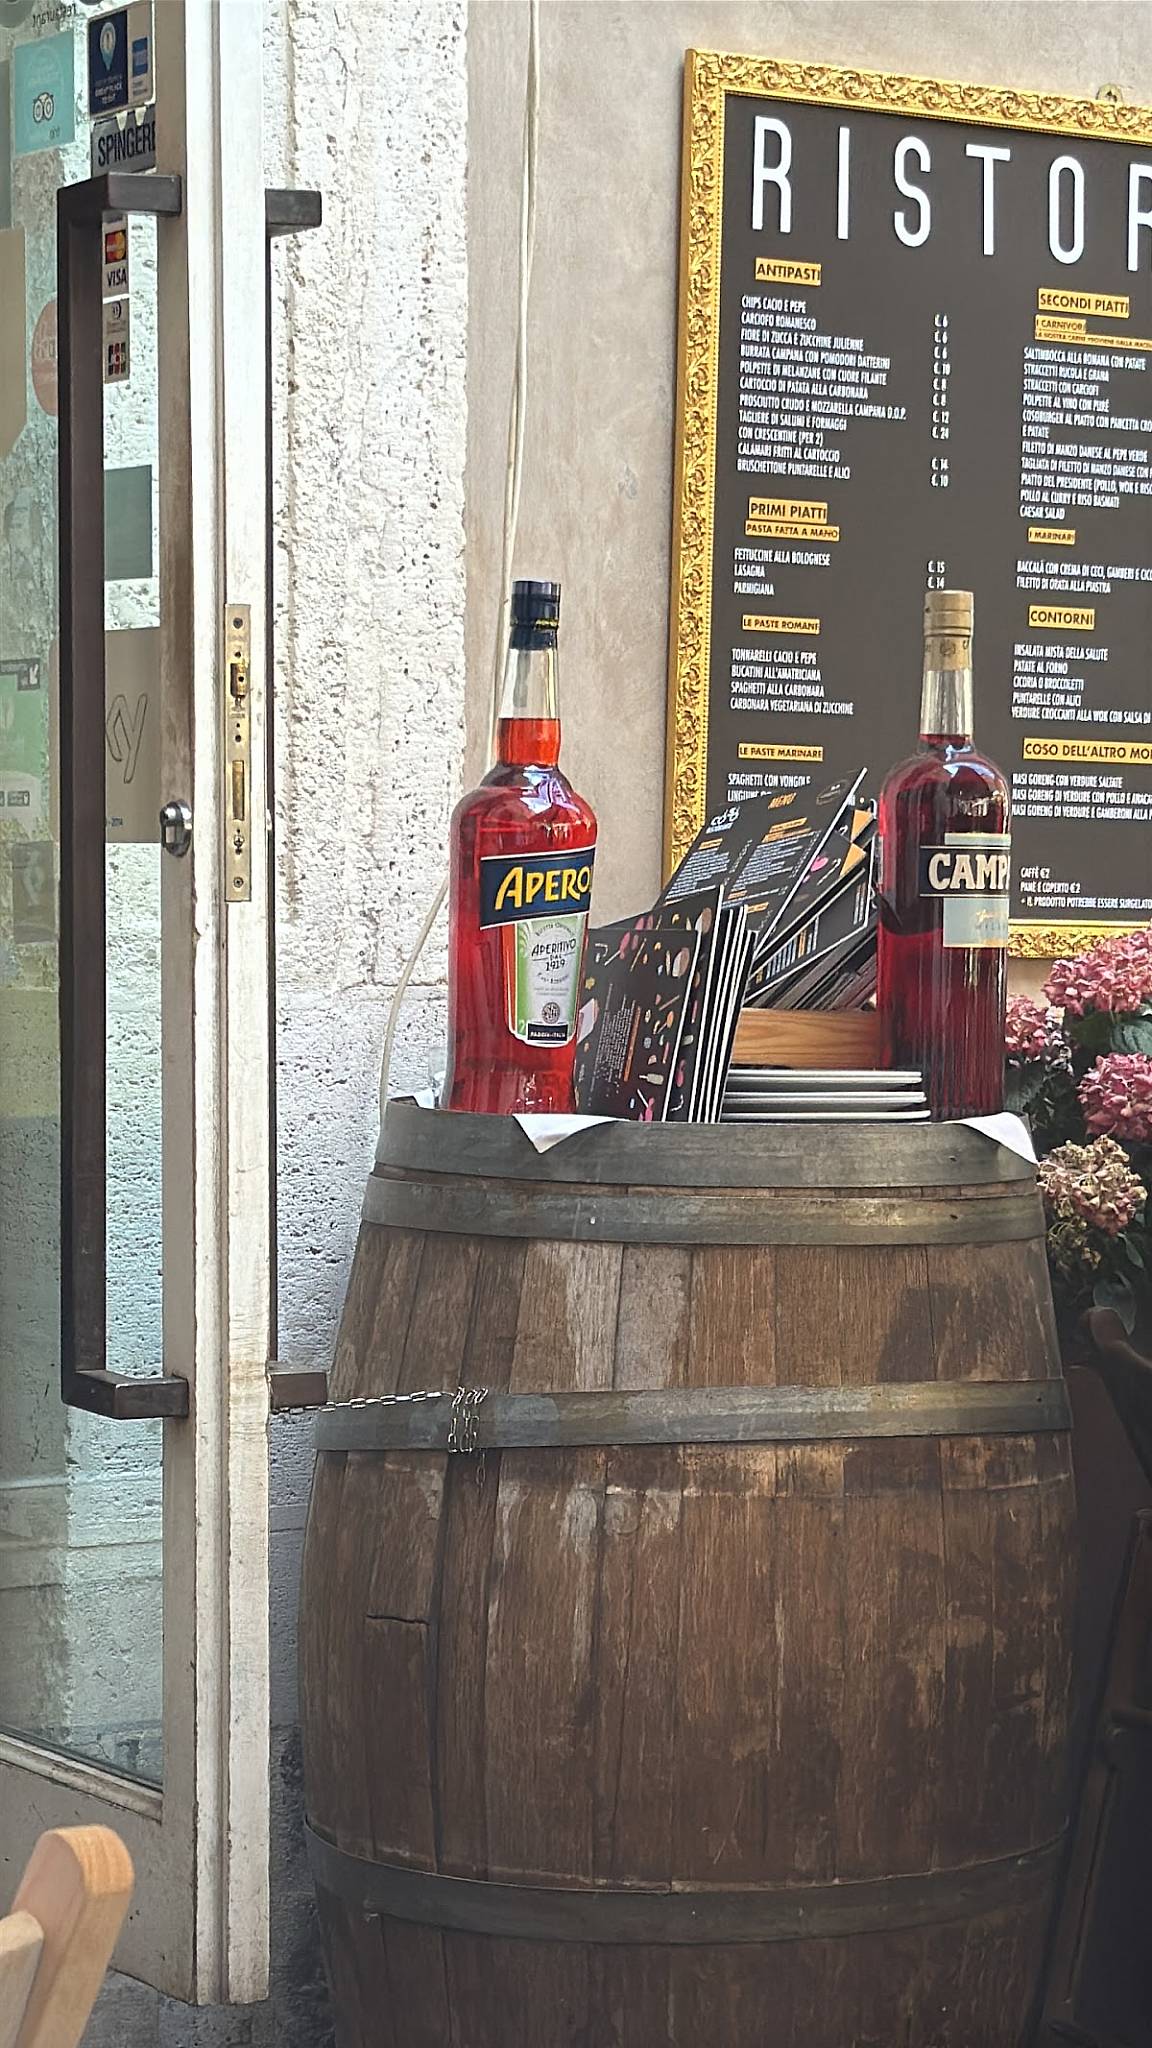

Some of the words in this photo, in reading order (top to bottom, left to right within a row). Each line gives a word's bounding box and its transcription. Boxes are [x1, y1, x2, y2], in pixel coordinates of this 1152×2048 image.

[107, 268, 128, 288] VISA
[756, 263, 821, 281] ANTIPASTI
[741, 295, 762, 309] CHIPS
[763, 297, 783, 311] CACIO
[784, 299, 789, 312] E
[790, 299, 807, 313] PEPE
[1040, 293, 1091, 309] SECONDI
[1095, 299, 1128, 313] PIATTI
[741, 312, 775, 327] CARCIOFO
[775, 315, 817, 331] ROMANESCO
[741, 328, 760, 342] FIORE
[761, 330, 770, 343] DI
[771, 331, 793, 345] ZUCCA
[794, 333, 799, 346] E
[799, 333, 833, 348] ZUCCHINE
[833, 336, 864, 351] JULIENNE
[740, 345, 771, 359] BURRATA
[772, 347, 804, 362] CAMPANA
[805, 350, 820, 363] CON
[820, 351, 857, 366] POMODORI
[857, 354, 891, 369] DATTERINI
[740, 361, 771, 376] POLPETTE
[773, 363, 781, 376] DI
[782, 364, 820, 380] MELANZANE
[822, 367, 837, 381] CON
[838, 369, 860, 383] CUORE
[861, 371, 887, 385] FILANTE
[739, 377, 777, 392] CARTOCCIO
[778, 380, 786, 393] DI
[787, 380, 811, 395] PATATA
[811, 382, 828, 396] ALLA
[828, 384, 869, 400] CARBONARA
[739, 394, 780, 410] PROSCIUTTO
[781, 397, 804, 412] CRUDO
[805, 399, 810, 412] E
[811, 400, 853, 416] MOZZARELLA
[854, 403, 886, 418] CAMPANA
[887, 406, 907, 420] D.O.P.
[739, 410, 769, 425] TAGLIERE
[771, 413, 779, 425] DI
[780, 413, 805, 427] SALUMI
[806, 415, 811, 428] E
[811, 416, 847, 431] FORMAGGI
[941, 411, 950, 424] 12
[738, 426, 753, 440] CON
[754, 427, 797, 443] CRESCENTINE
[798, 431, 815, 444] (PER
[815, 432, 824, 446] 2)
[940, 427, 949, 440] 24
[738, 442, 772, 457] CALAMARI
[773, 445, 793, 459] FRITTI
[794, 446, 803, 460] AL
[803, 447, 840, 462] CARTOCCIO
[940, 474, 949, 487] 10
[750, 502, 786, 517] PRIMI
[790, 505, 827, 520] PIATTI
[746, 524, 772, 534] PASTA
[775, 526, 799, 536] FATTA
[801, 528, 808, 536] A
[810, 528, 838, 539] MANO
[734, 547, 773, 563] FETTUCCINE
[774, 550, 790, 564] ALLA
[791, 551, 831, 566] BOLOGNESE
[734, 564, 765, 578] LASAGNA
[936, 560, 945, 574] 15
[733, 582, 775, 596] PARMIGIANA
[936, 576, 945, 589] 14
[743, 618, 752, 627] LE
[754, 619, 779, 629] PASTE
[1030, 610, 1093, 625] CONTORNI
[731, 648, 772, 662] TONNARELLI
[773, 650, 793, 663] CACIO
[795, 651, 799, 664] E
[800, 651, 817, 665] PEPE
[731, 665, 763, 679] BUCATINI
[764, 666, 821, 682] ALL'AMATRICIANA
[730, 681, 766, 695] SPAGHETTI
[767, 683, 784, 696] ALLA
[784, 684, 825, 698] CARBONARA
[730, 697, 769, 711] CARBONARA
[770, 699, 813, 713] VEGETARIANA
[814, 701, 822, 714] DI
[822, 701, 854, 715] ZUCCHINE
[739, 747, 748, 756] LE
[750, 748, 775, 757] PASTE
[777, 748, 822, 758] MARINARE
[1025, 743, 1059, 756] COSO
[1062, 745, 1127, 759] DELL'ALTRO
[728, 773, 763, 786] SPAGHETTI
[764, 774, 779, 786] CON
[928, 852, 1010, 890] CAMP
[1021, 866, 1039, 879] CAFFÈ
[495, 867, 593, 910] APERO
[531, 938, 577, 957] APERITIVO
[546, 959, 565, 971] 1919
